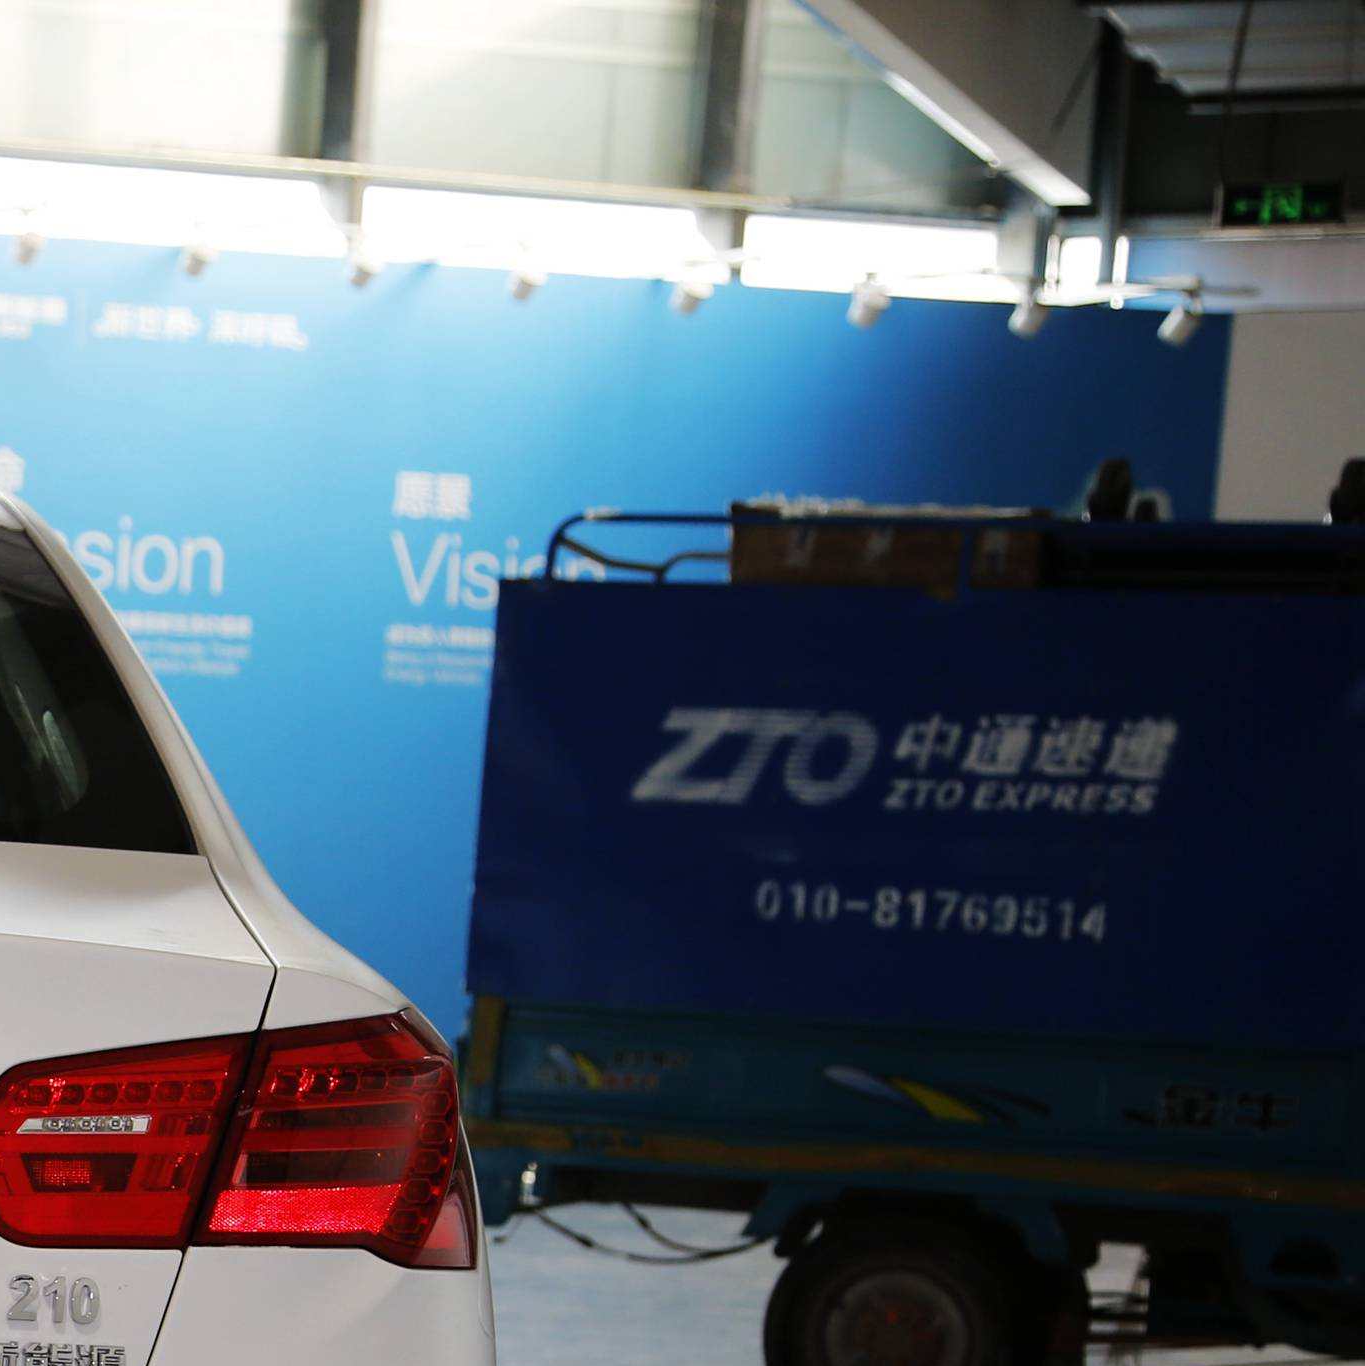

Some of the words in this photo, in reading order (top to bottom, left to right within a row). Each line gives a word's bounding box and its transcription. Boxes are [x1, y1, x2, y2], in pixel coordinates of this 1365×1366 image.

[52, 514, 225, 595] sion
[632, 708, 878, 805] ZTO
[884, 779, 965, 811] ZTO
[971, 781, 1159, 815] EXPRESS
[5, 1274, 101, 1325] 210
